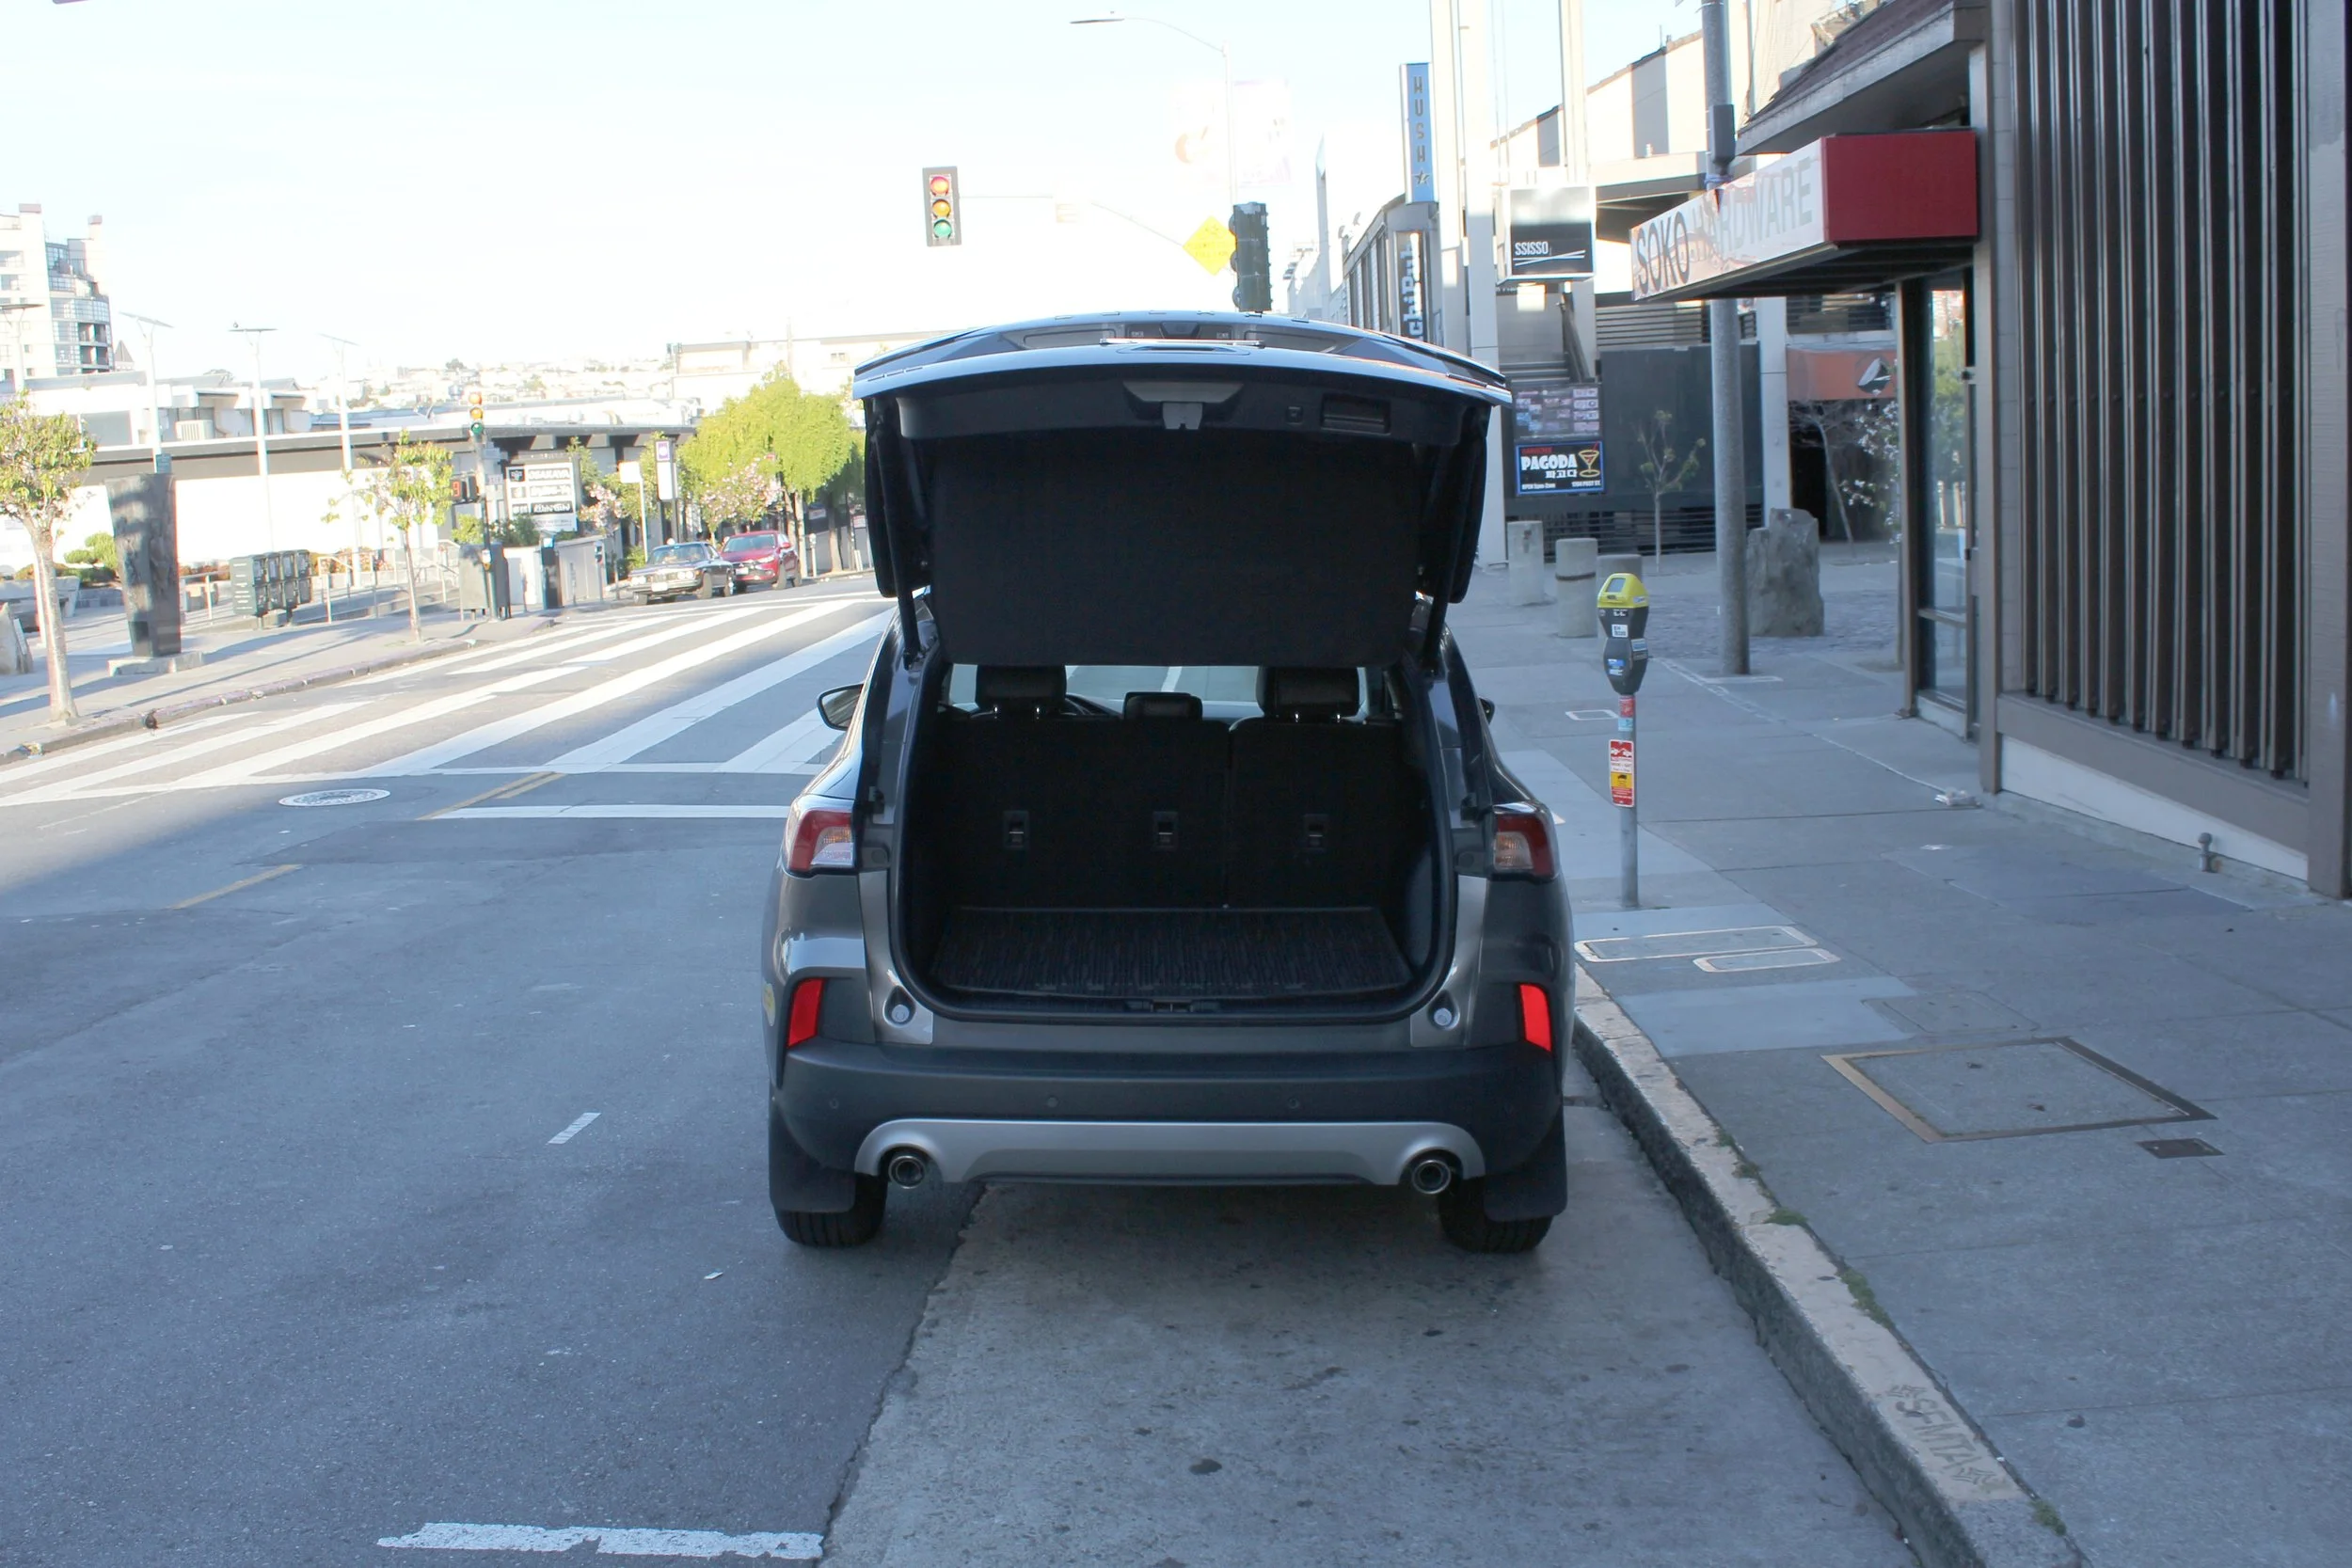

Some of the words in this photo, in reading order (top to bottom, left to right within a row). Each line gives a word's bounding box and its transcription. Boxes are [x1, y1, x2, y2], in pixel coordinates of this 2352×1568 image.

[1414, 76, 1426, 163] HUSH
[1515, 241, 1549, 256] SSISSO
[1636, 211, 1690, 294] SOKO
[1520, 453, 1578, 470] PAGODA
